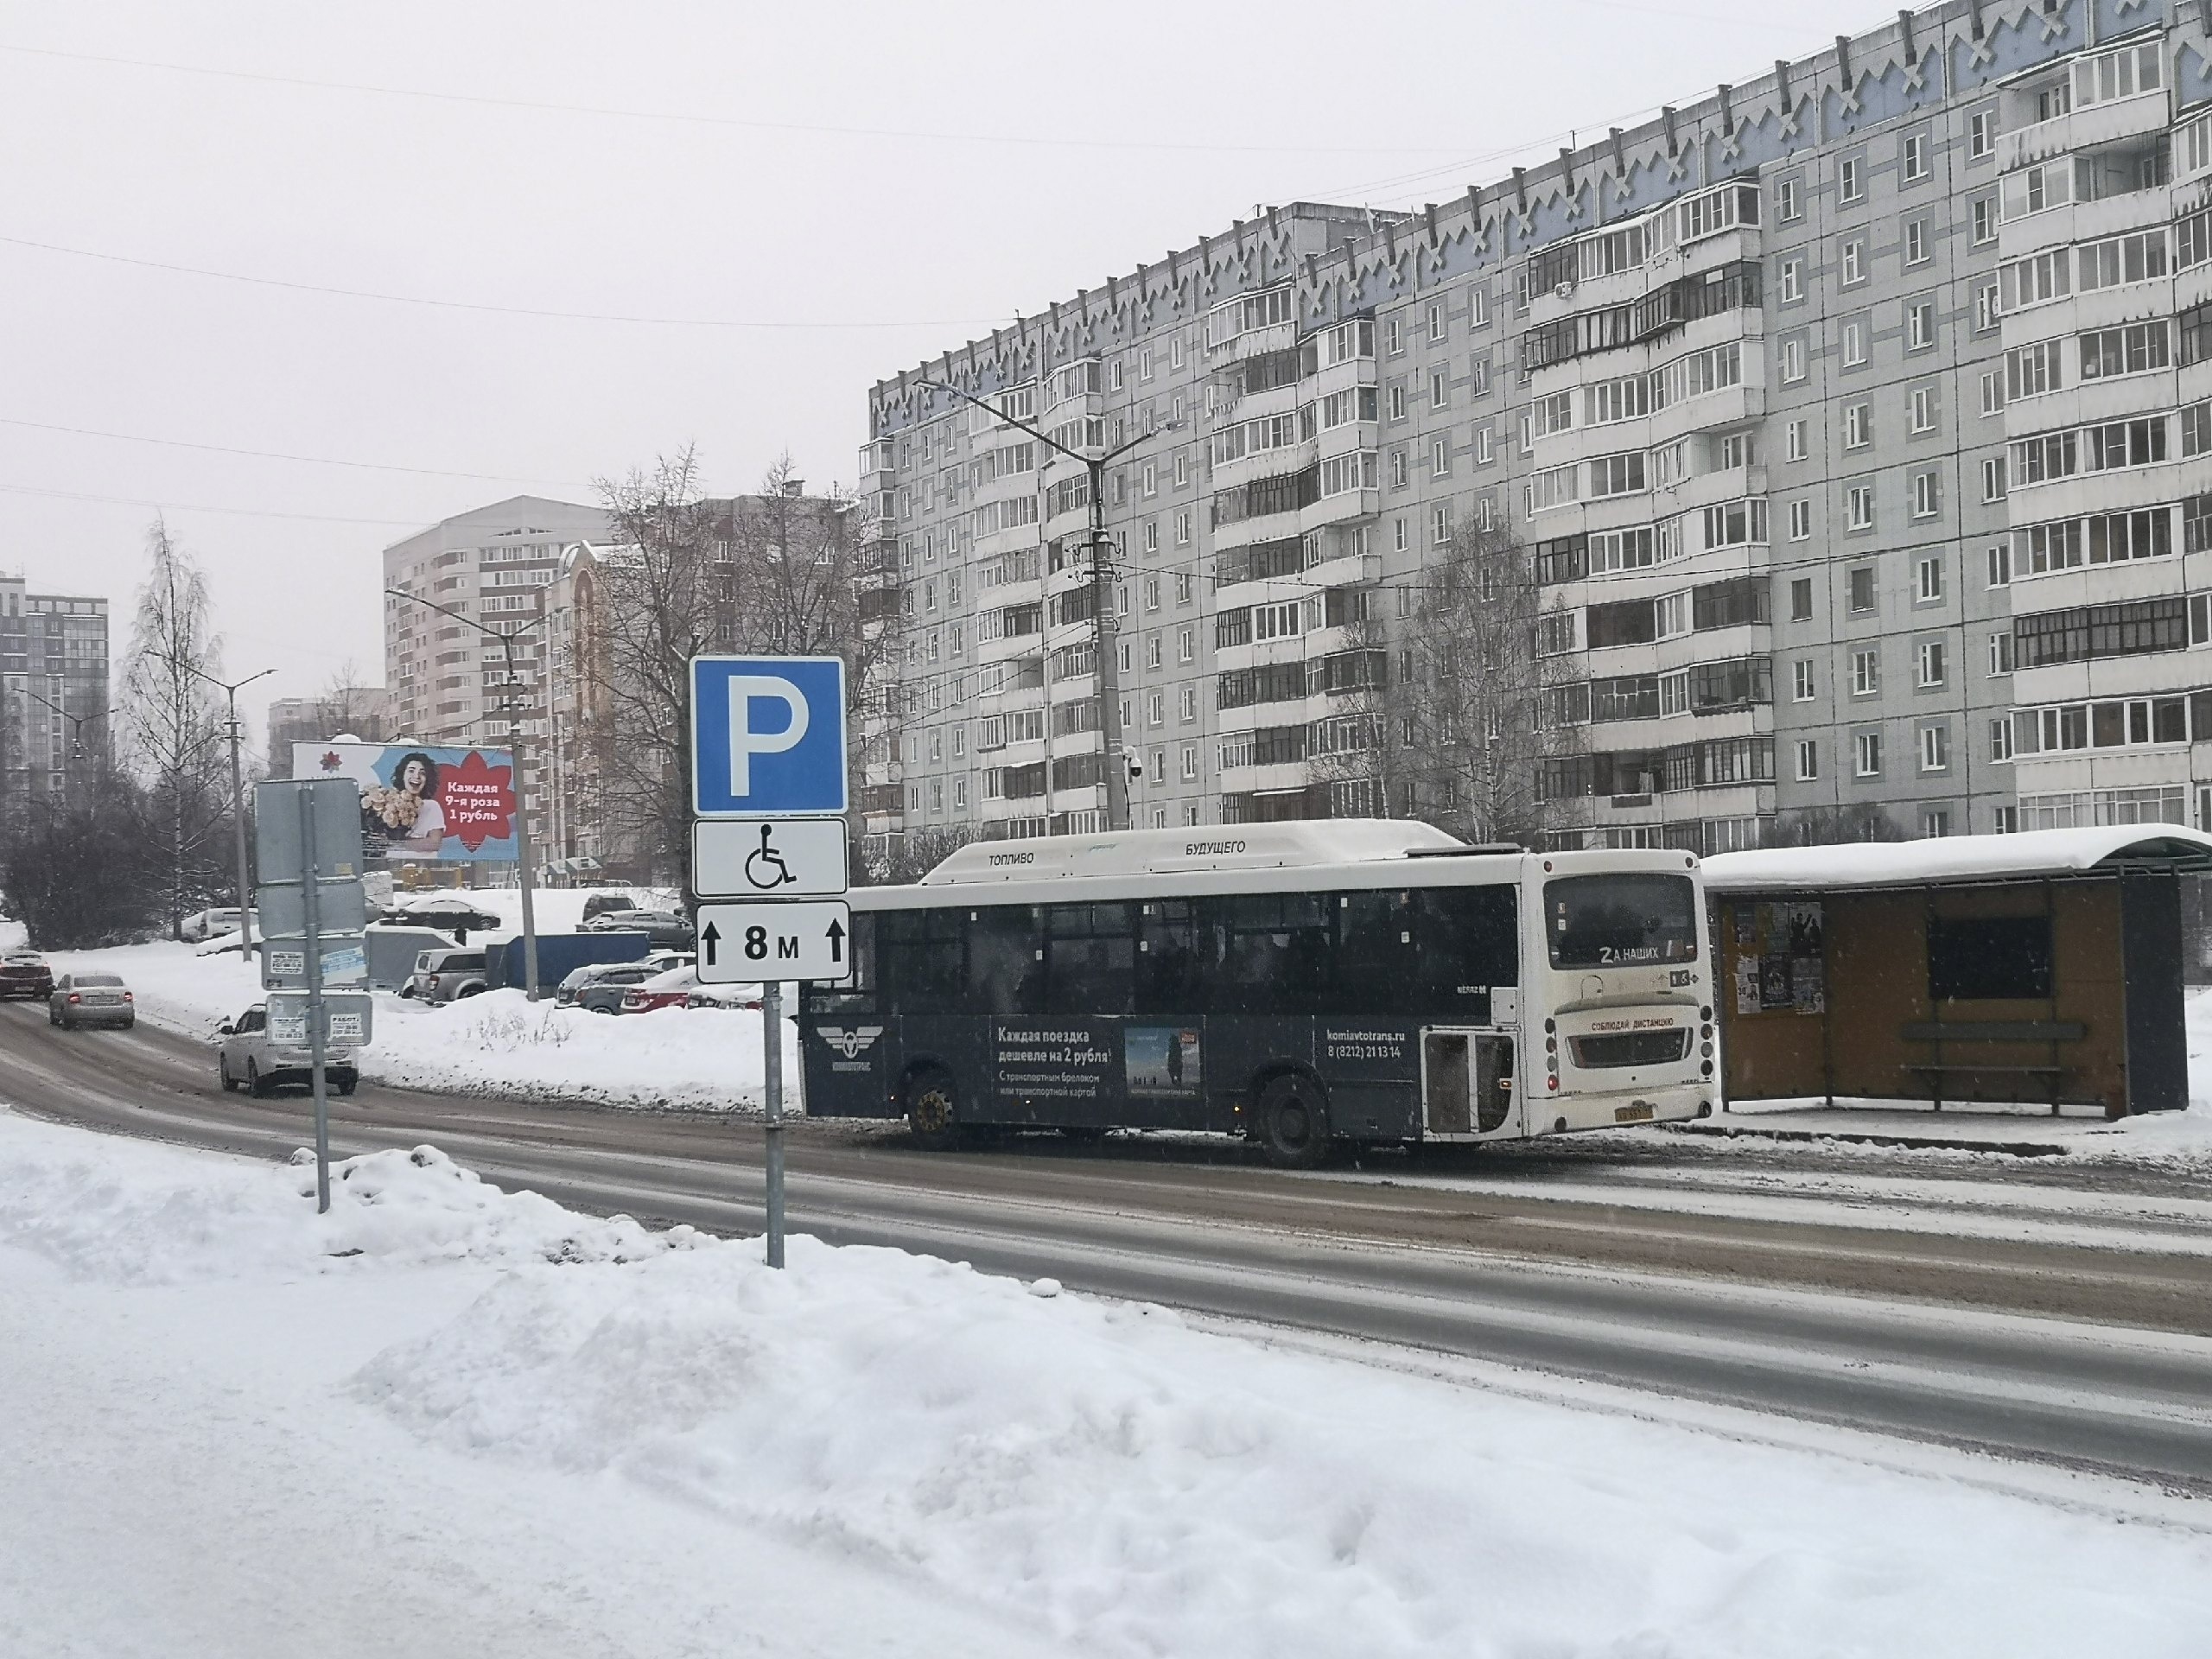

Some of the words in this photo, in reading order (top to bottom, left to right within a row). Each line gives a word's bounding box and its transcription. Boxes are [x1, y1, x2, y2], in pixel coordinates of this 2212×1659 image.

[728, 675, 810, 797] P
[448, 781, 499, 794] Каждая
[445, 795, 467, 806] 9-я
[470, 798, 500, 810] роза
[449, 809, 457, 819] 1
[460, 810, 498, 823] рубль
[989, 852, 1034, 866] ТОПЛИВО
[1185, 840, 1246, 855] БУДУЩЕГО
[744, 925, 768, 960] 8
[1623, 947, 1659, 961] НАШИХ
[1592, 1019, 1630, 1031] СОБЛЮДАЙ
[1633, 1017, 1674, 1028] ДИСТАНЦИЮ
[998, 1027, 1040, 1043] Каждая
[1042, 1031, 1090, 1044] поездка
[1327, 1029, 1405, 1041] komiavtotrans.ru
[998, 1051, 1047, 1063] дешевле
[1049, 1052, 1063, 1062] на
[1064, 1047, 1071, 1062] 2
[1328, 1046, 1335, 1057] 8
[1337, 1046, 1364, 1058] (8212)
[1366, 1046, 1376, 1057] 21
[1378, 1046, 1388, 1057] 13
[1389, 1046, 1401, 1058] 14
[999, 1071, 1006, 1081] С
[1007, 1073, 1060, 1083] транспортным
[1061, 1071, 1100, 1084] брелоком
[1016, 1086, 1068, 1097] транспортной
[1069, 1085, 1096, 1099] картой
